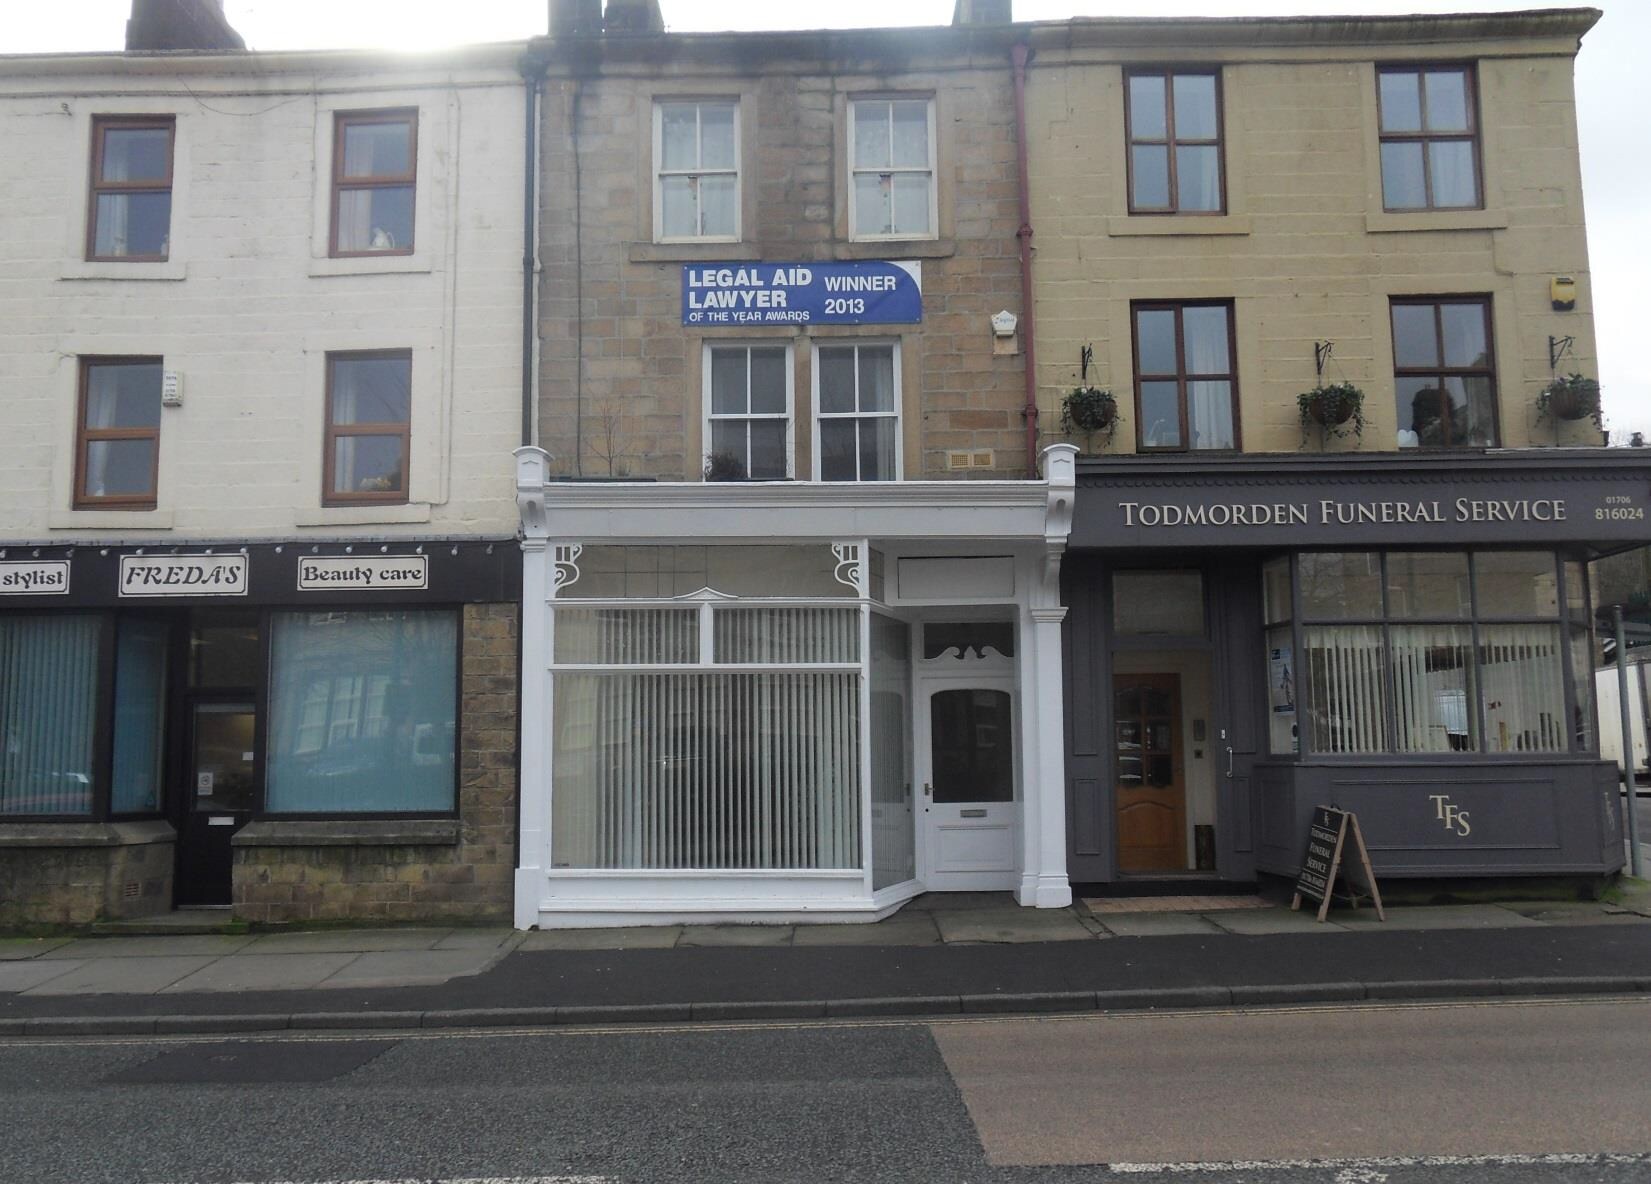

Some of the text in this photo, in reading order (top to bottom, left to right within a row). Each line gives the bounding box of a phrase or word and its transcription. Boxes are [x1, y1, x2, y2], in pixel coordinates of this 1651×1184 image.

[689, 268, 813, 287] LEGAL AID
[824, 276, 897, 292] WINNER
[688, 290, 788, 309] LAWYER
[824, 298, 865, 314] 2013
[689, 311, 810, 322] OF THE YEAR AWARDS
[1606, 496, 1632, 504] 01706
[1118, 498, 1567, 526] TODMORDEN FUNERAL SERVICE
[1595, 507, 1644, 520] 816024
[2, 569, 64, 590] stylist
[126, 565, 241, 585] FREDA'S
[303, 566, 423, 585] Beauty care
[1428, 794, 1471, 837] TFS
